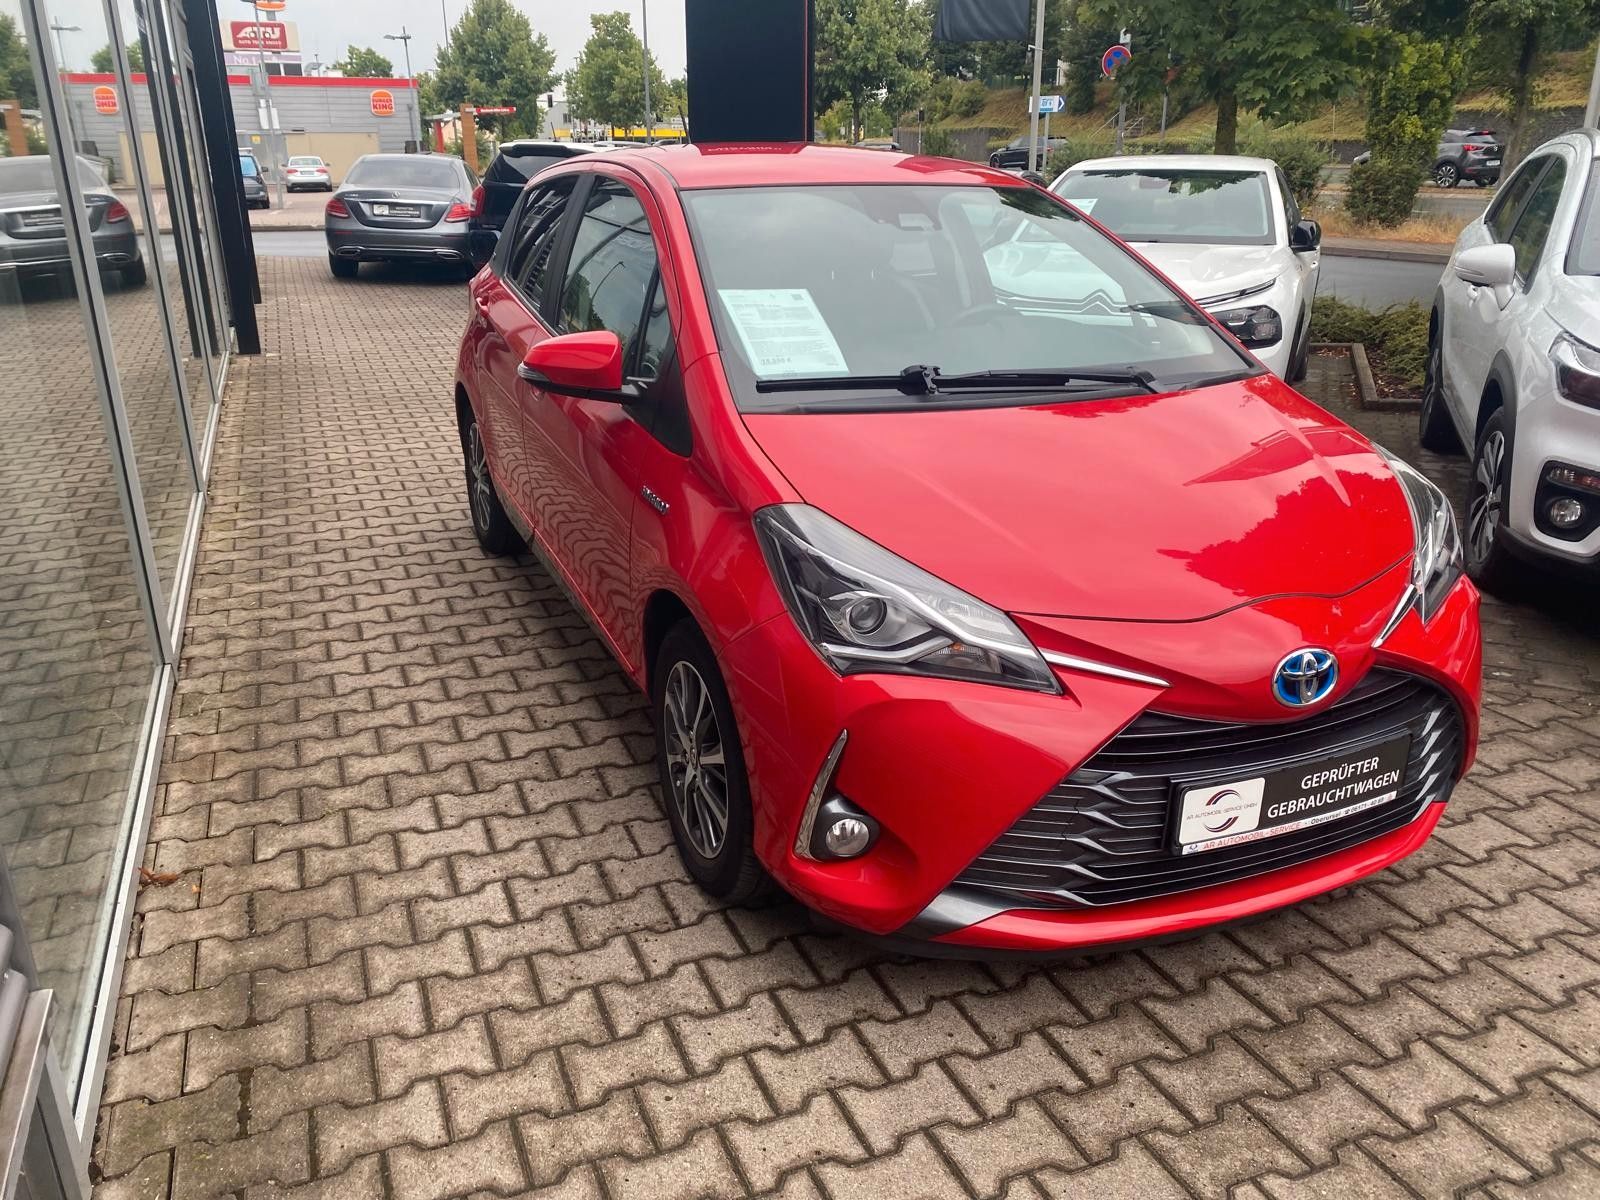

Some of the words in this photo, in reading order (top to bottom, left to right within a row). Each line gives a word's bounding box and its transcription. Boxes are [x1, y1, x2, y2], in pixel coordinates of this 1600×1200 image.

[1301, 756, 1380, 790] GEPRÜFTER
[1267, 769, 1400, 818] GEBRAUCHTWAGEN
[1202, 842, 1216, 850] AR
